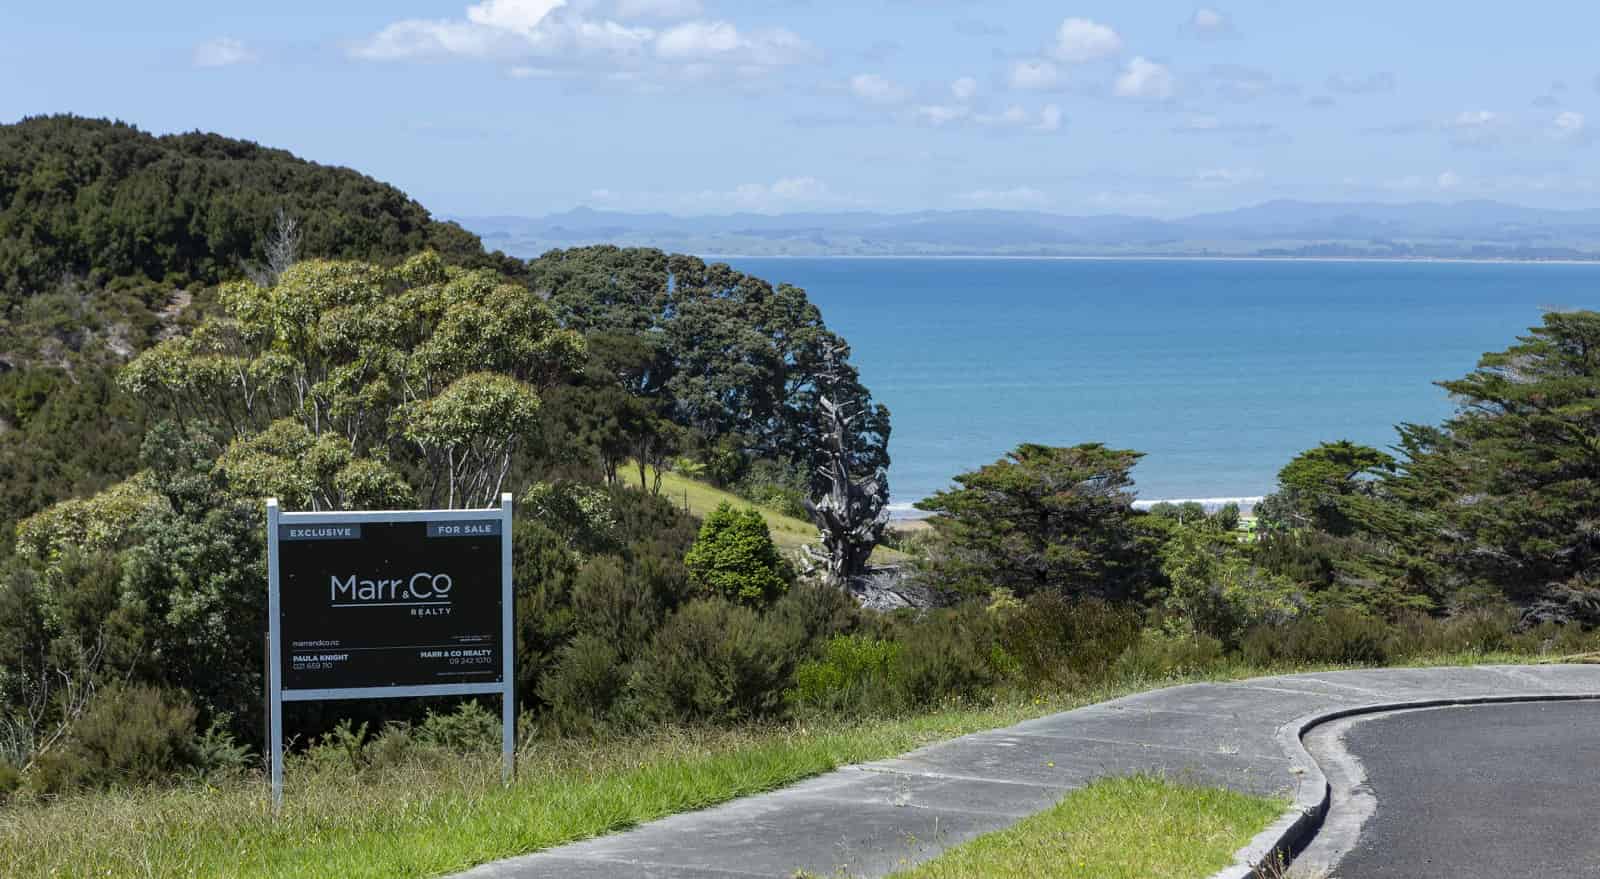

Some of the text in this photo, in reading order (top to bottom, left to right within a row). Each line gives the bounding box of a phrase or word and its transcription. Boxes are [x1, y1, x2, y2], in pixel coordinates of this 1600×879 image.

[290, 528, 351, 537] EXCLUSIVE
[438, 524, 492, 535] FOR SALE
[410, 608, 451, 616] REALTY
[319, 654, 349, 662] KNIGHT
[420, 650, 443, 658] MARR
[462, 649, 492, 657] REALTY
